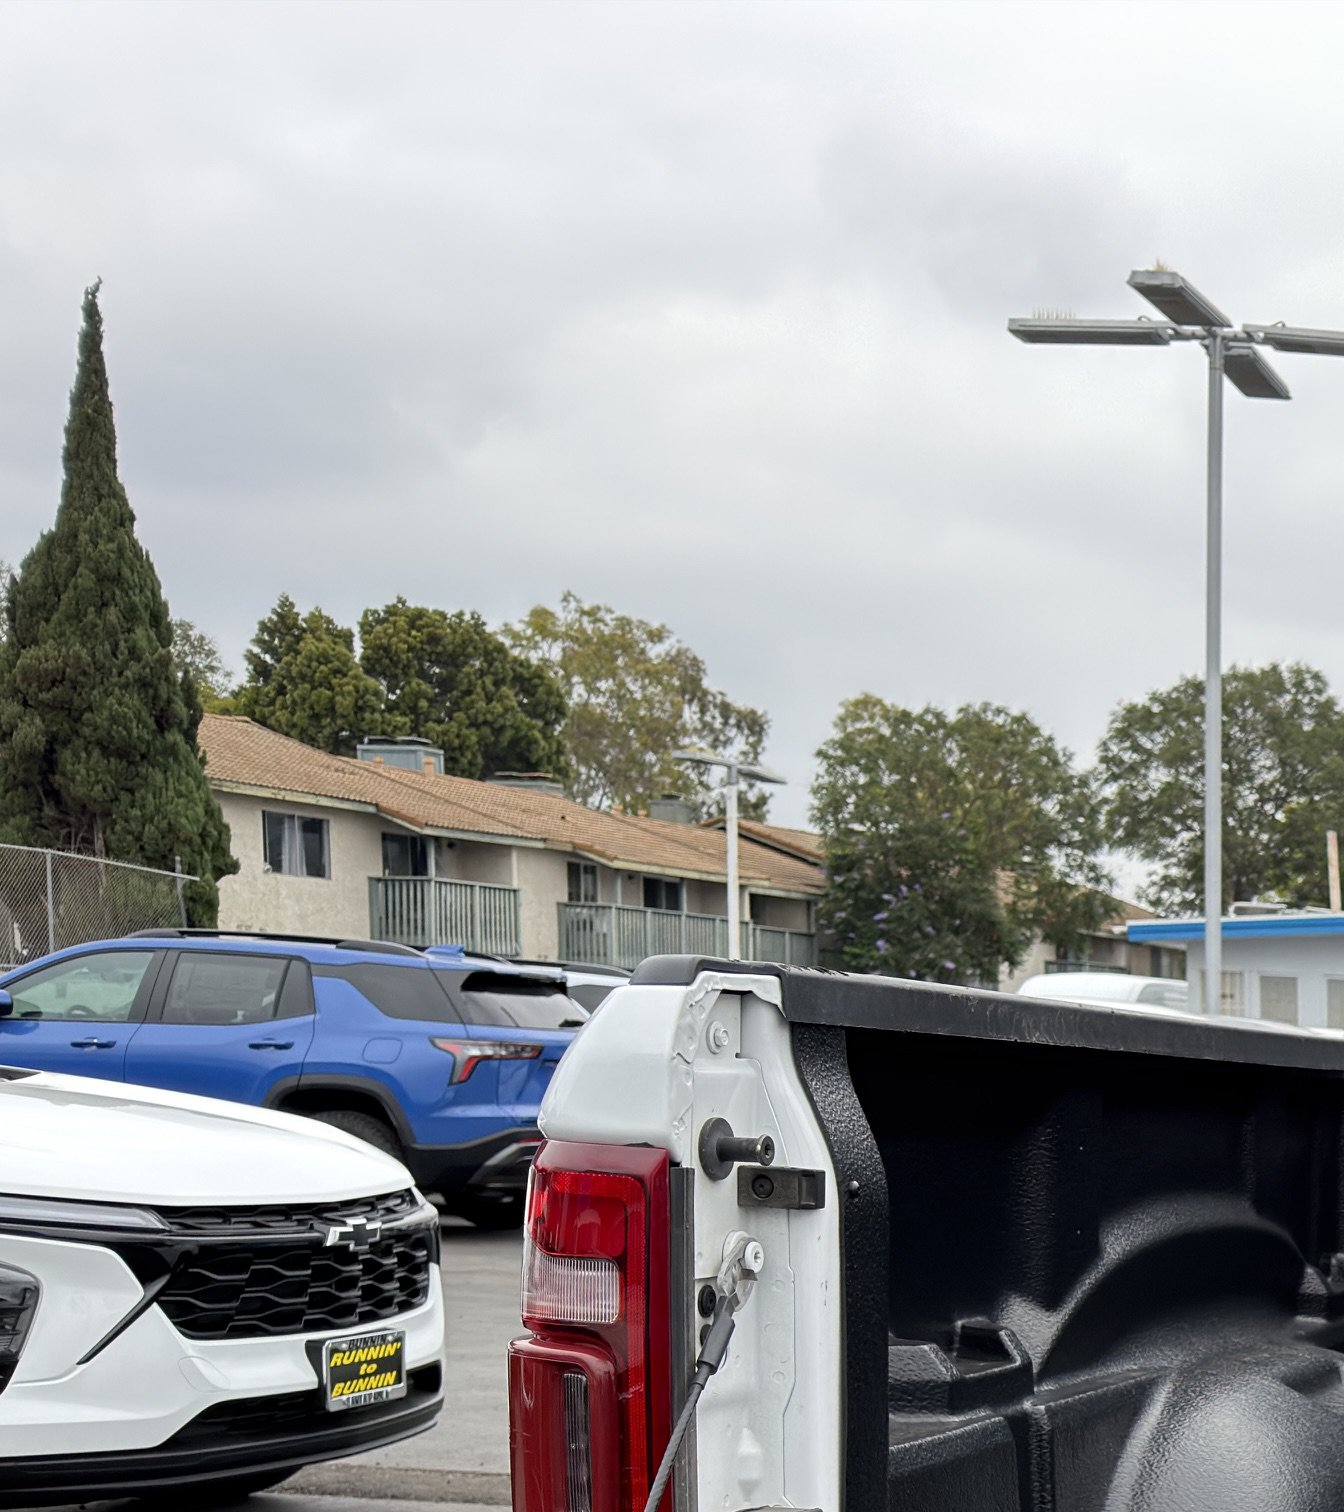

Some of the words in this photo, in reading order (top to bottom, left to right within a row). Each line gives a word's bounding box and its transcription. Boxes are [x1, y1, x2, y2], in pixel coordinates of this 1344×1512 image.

[330, 1342, 401, 1368] RUNNIN'
[360, 1363, 377, 1375] to
[331, 1370, 397, 1399] BUNNIN
